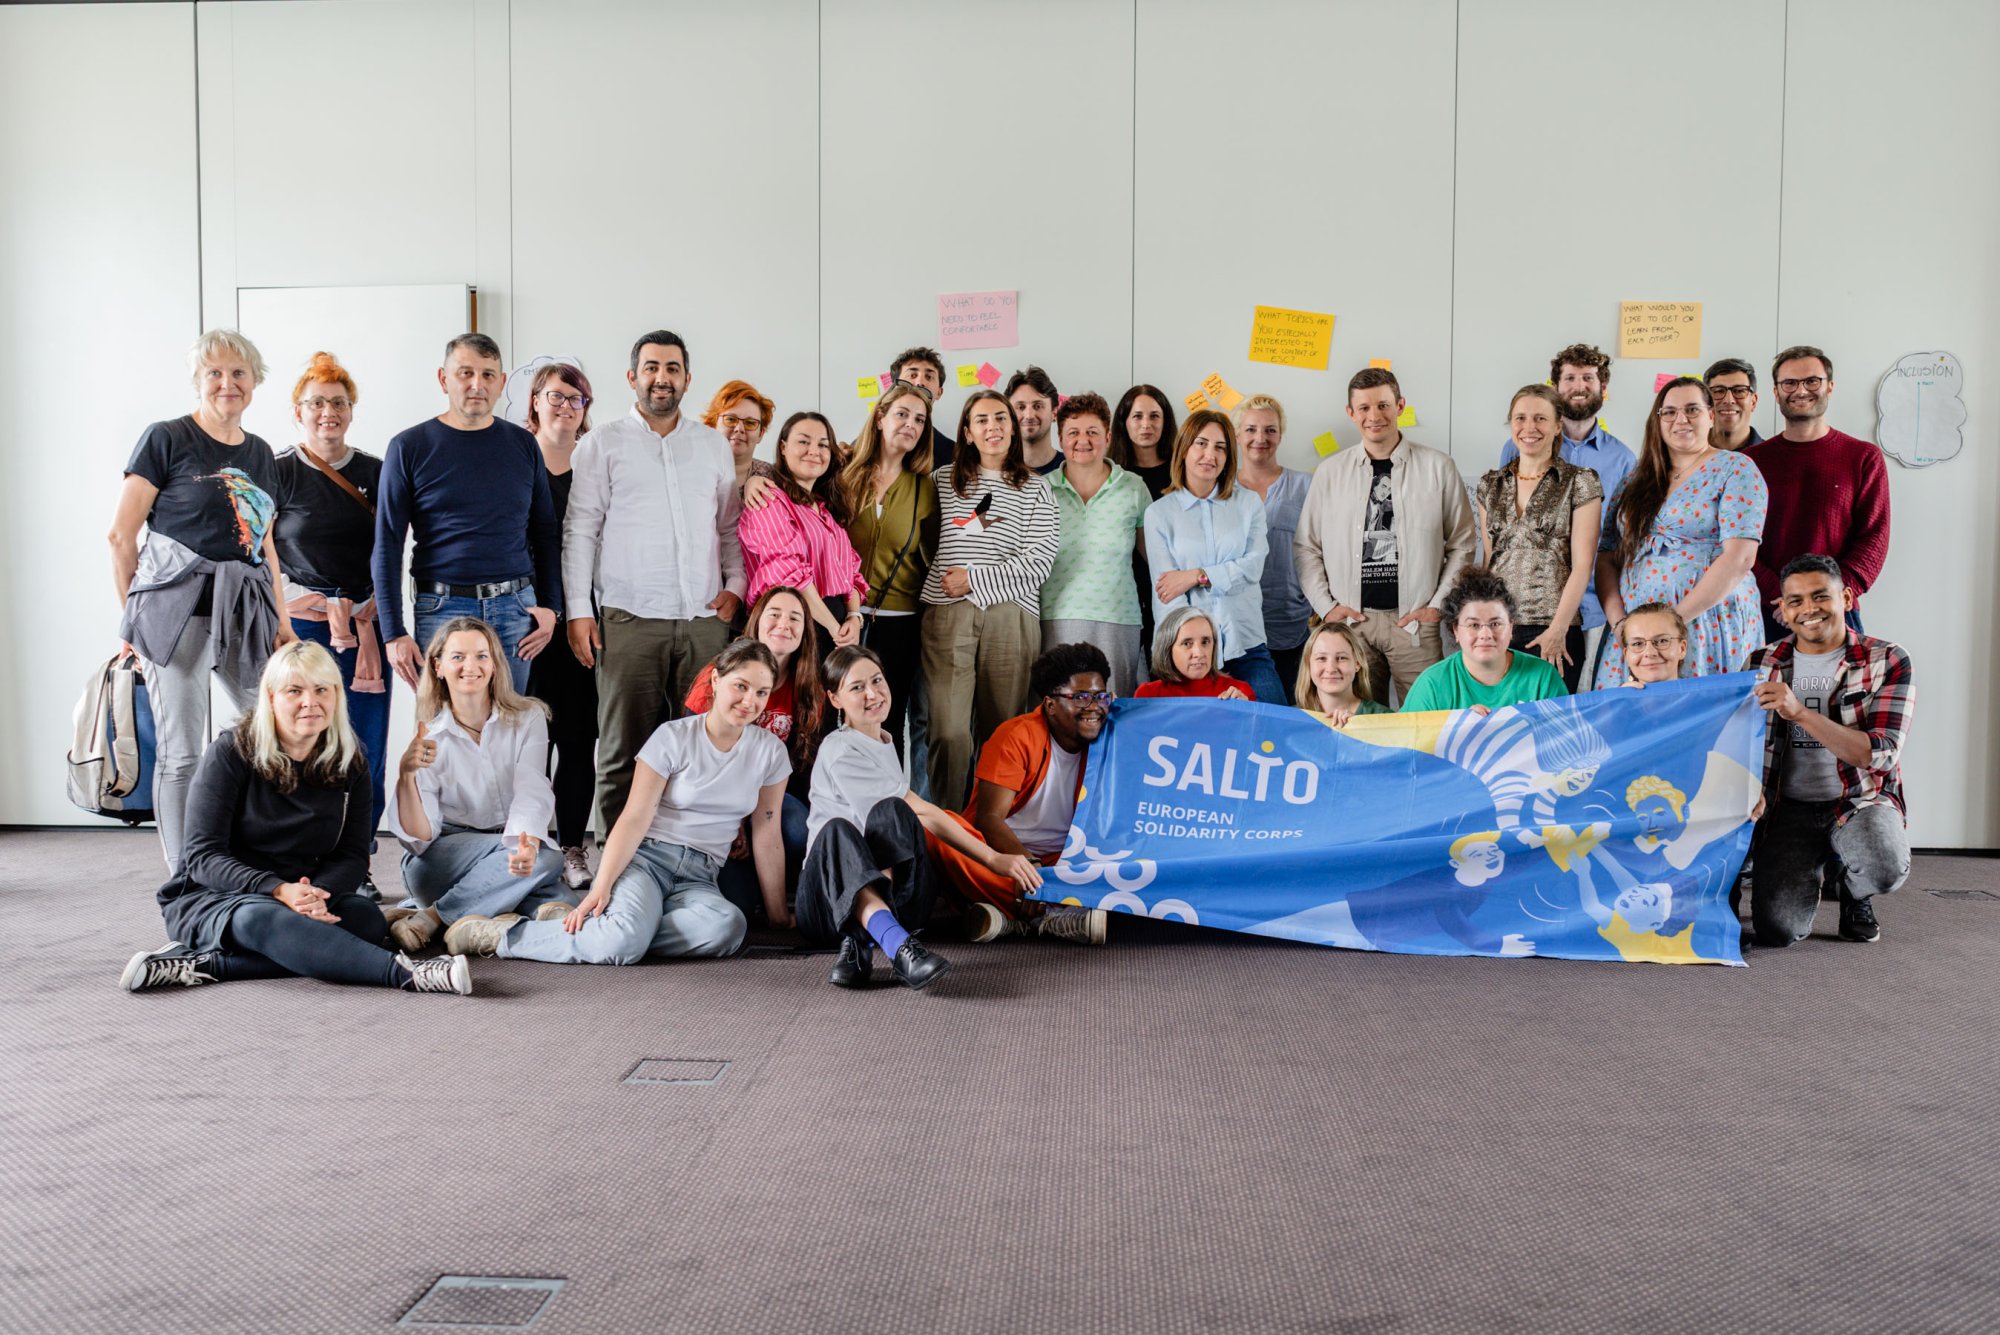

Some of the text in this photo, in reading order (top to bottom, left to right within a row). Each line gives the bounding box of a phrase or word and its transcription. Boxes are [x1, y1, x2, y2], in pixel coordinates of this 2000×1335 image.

[941, 295, 1016, 308] WHAT DO YOU
[1623, 303, 1695, 313] WHAT WOULD YOU
[941, 313, 964, 325] NEED
[967, 313, 978, 322] TO
[1257, 310, 1329, 326] WHAT TOPICS ARE
[1623, 314, 1695, 325] LIKE TO GET OR
[1257, 323, 1318, 338] YOU ESPECIALLY
[1626, 327, 1649, 336] LEARN
[1648, 330, 1681, 344] OTHER?
[1254, 337, 1301, 346] INTERESTED
[1265, 347, 1278, 355] THE
[1143, 735, 1320, 805] SALTO
[1137, 801, 1235, 825] EUROPEAN
[1133, 820, 1305, 840] SOLIDARITY CORPS
